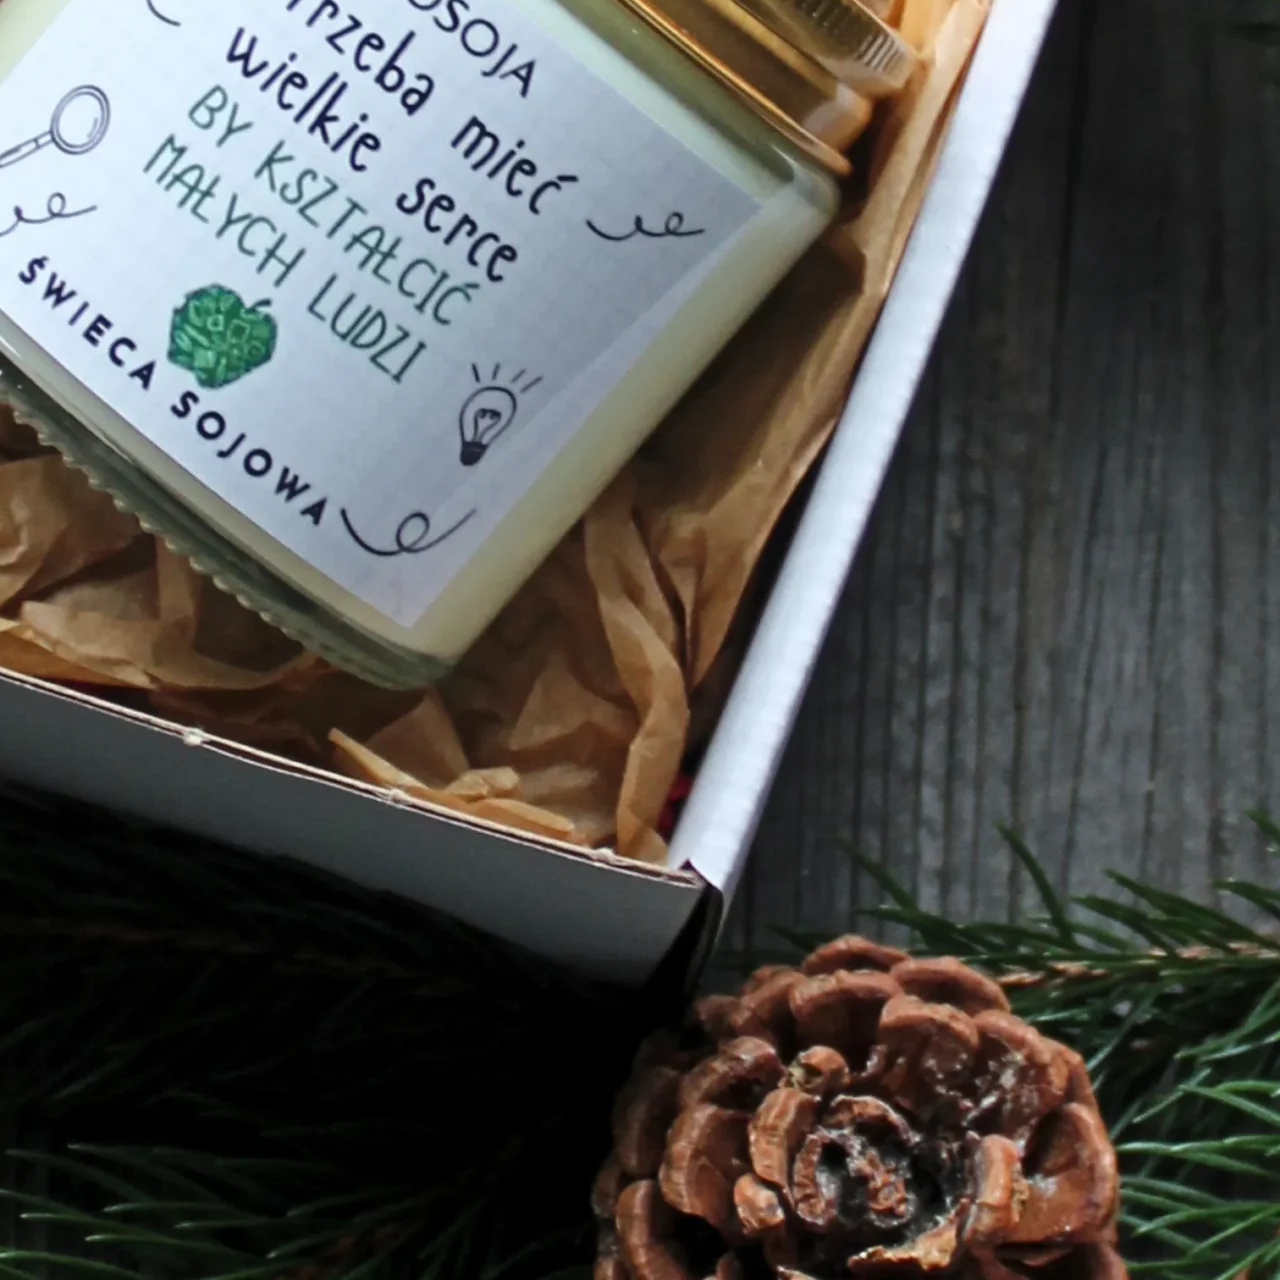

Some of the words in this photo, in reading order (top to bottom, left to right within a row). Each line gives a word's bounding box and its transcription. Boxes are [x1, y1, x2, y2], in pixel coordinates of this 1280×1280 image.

[142, 133, 307, 288] MAŁYCH
[306, 273, 428, 384] LUDZI
[187, 84, 254, 149] BY
[253, 139, 481, 327] KSZTAŁCIĆ
[225, 26, 382, 172] wielkie
[395, 177, 519, 284] serce
[449, 115, 580, 216] mieć
[17, 255, 158, 391] ŚWIECA
[169, 390, 329, 527] SOJOWA
